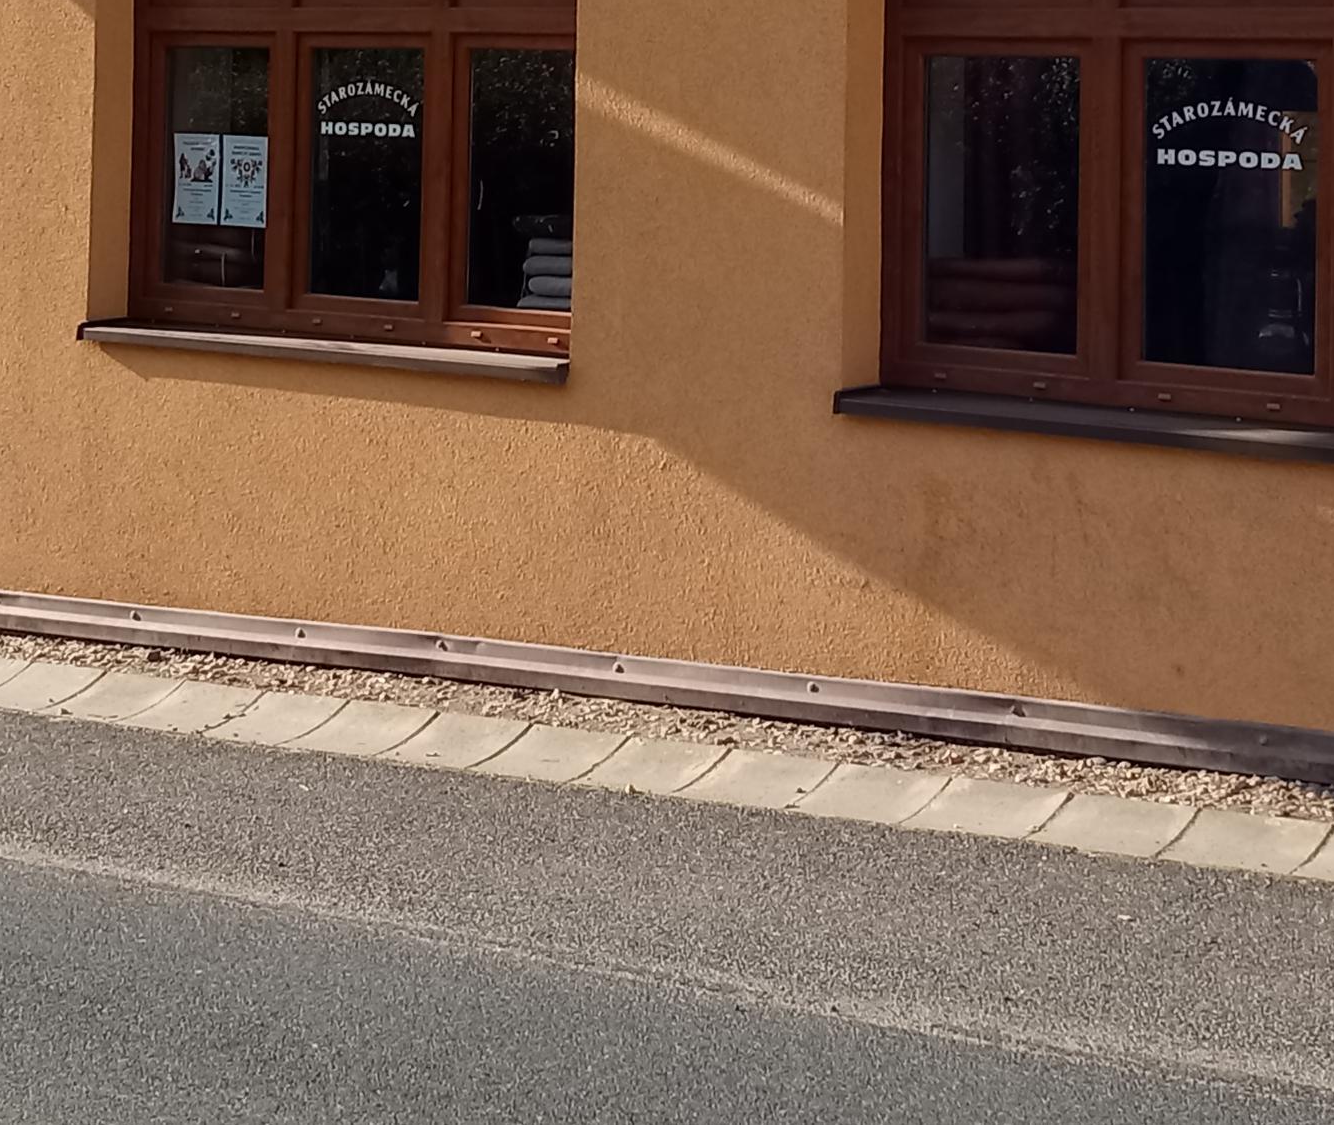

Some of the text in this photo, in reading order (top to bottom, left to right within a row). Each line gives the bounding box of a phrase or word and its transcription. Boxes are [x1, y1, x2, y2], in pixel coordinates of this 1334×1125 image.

[317, 79, 420, 117] STAROZÁMECKÁ
[320, 121, 415, 139] HOSPODA
[1152, 97, 1308, 145] STAROZÁMECKÁ
[1156, 148, 1303, 171] HOSPODA
